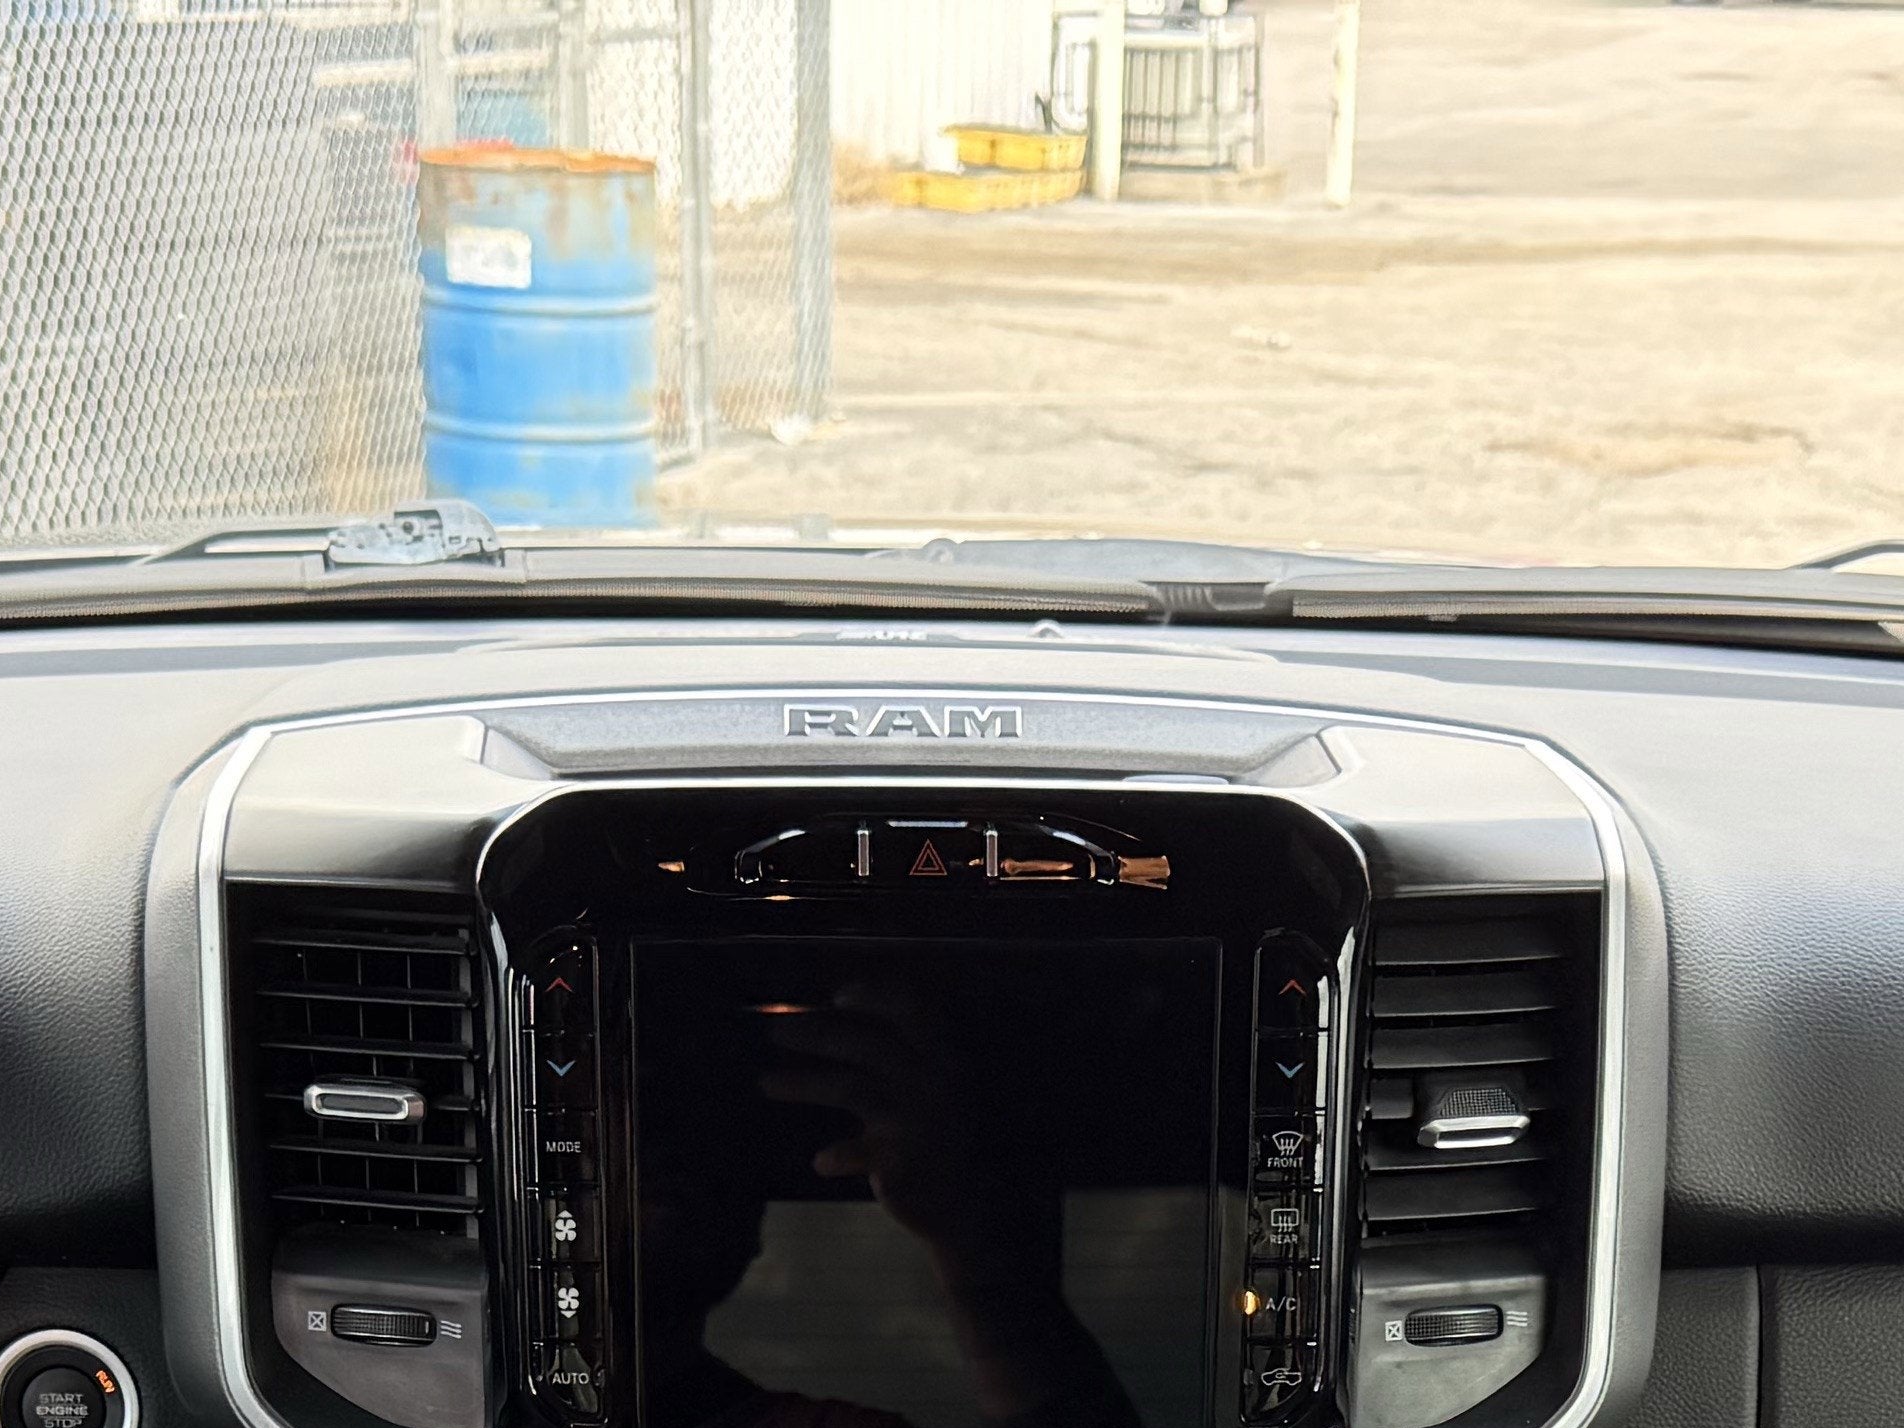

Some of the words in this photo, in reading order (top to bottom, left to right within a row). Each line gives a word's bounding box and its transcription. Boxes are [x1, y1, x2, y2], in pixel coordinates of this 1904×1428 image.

[783, 704, 1024, 738] RAM
[545, 1140, 582, 1154] MODE
[1267, 1156, 1305, 1169] FRONT
[1269, 1233, 1299, 1245] REAR
[1265, 1297, 1297, 1312] A/C
[552, 1371, 590, 1386] AUTO
[39, 1393, 85, 1404] START
[35, 1405, 89, 1417] ENGINE
